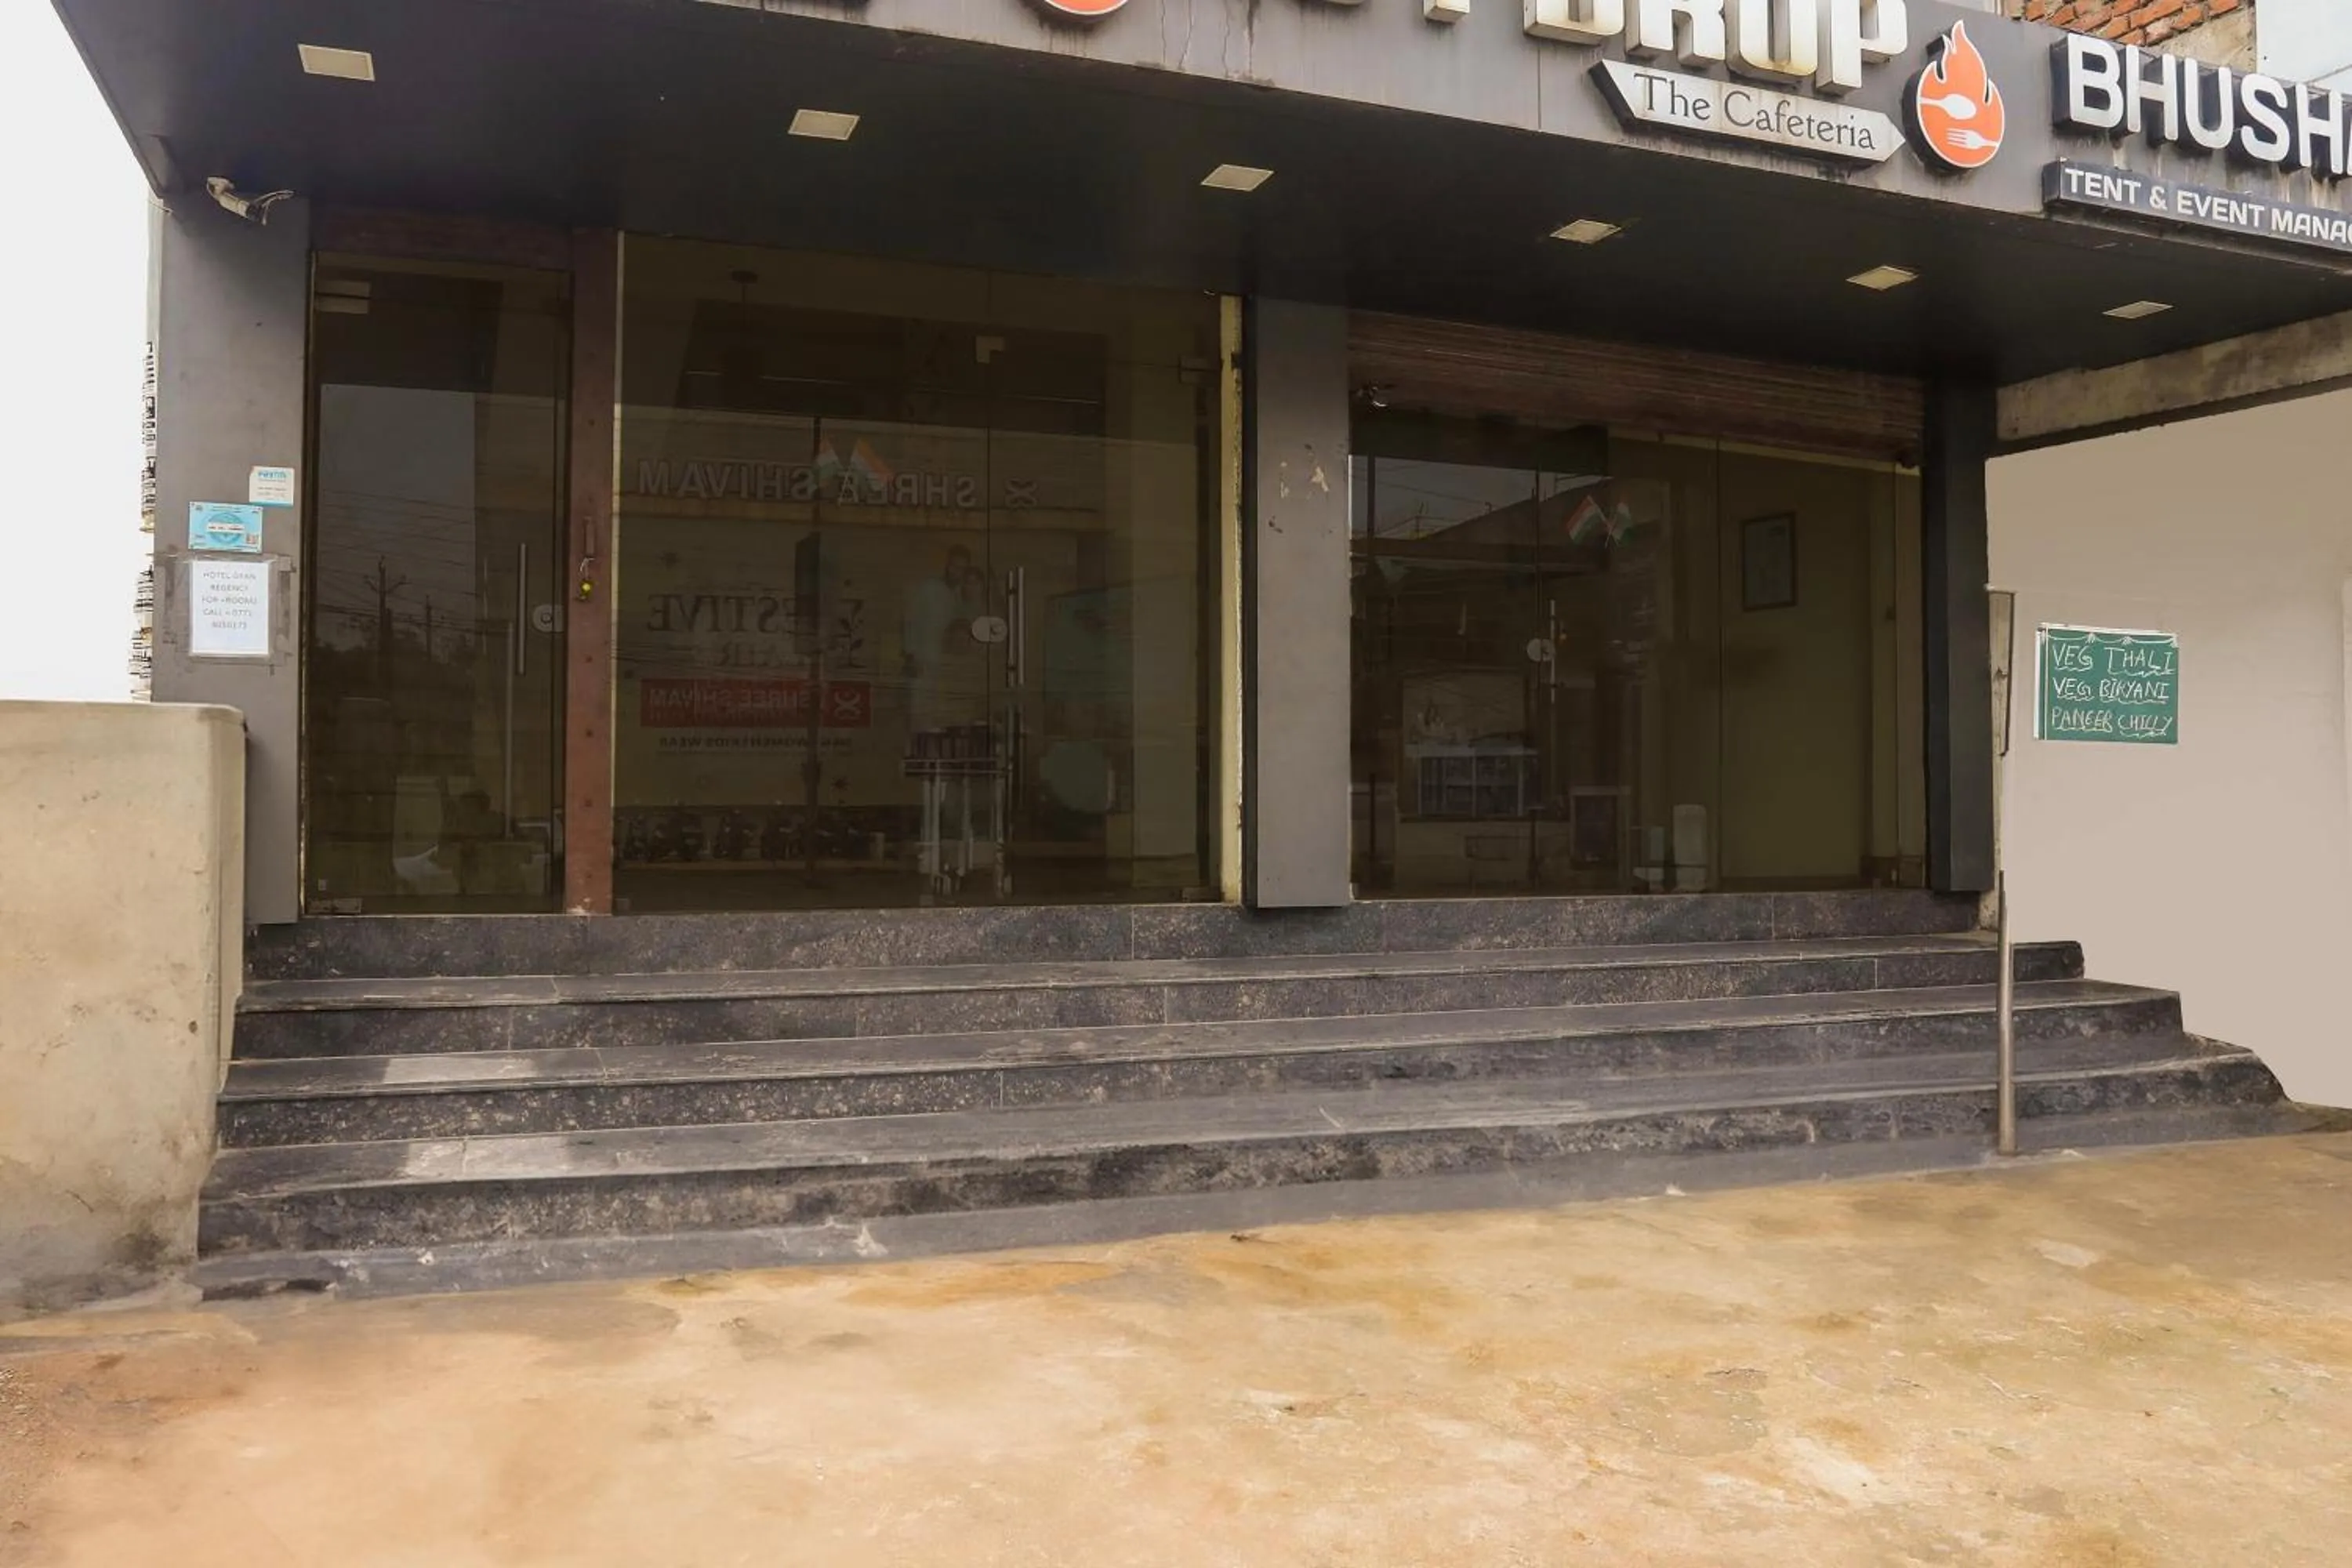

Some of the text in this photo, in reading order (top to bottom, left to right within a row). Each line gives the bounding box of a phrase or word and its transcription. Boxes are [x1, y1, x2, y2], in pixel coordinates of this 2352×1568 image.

[1634, 72, 1876, 151] The Cafeteria
[2067, 32, 2352, 176] BHUSH
[2064, 168, 2352, 246] TENT & EVENT MANA
[2052, 643, 2175, 676] VEG THALI
[2053, 677, 2092, 697] VEG
